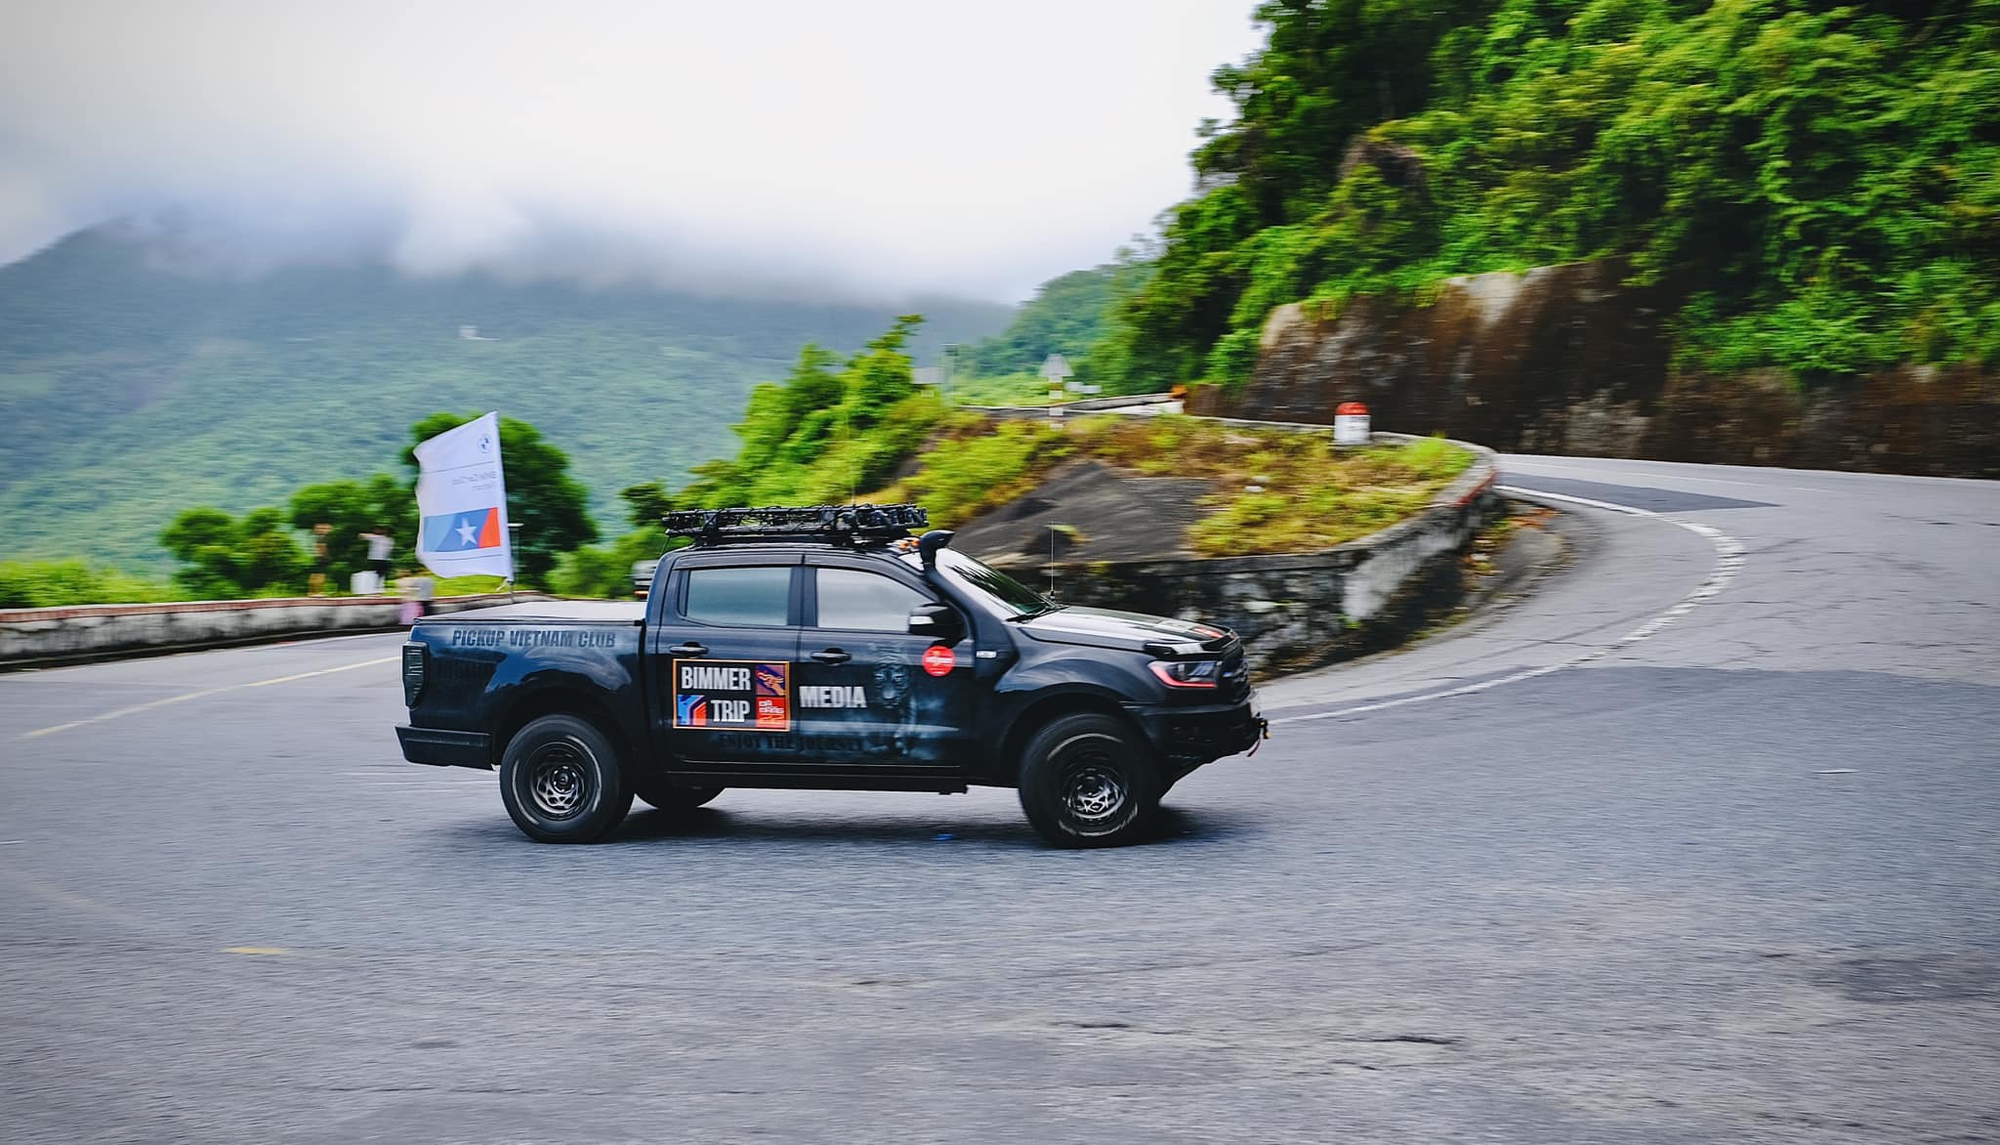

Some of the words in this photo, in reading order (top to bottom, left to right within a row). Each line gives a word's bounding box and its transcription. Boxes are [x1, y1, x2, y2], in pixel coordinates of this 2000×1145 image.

[452, 630, 505, 646] PICKUP
[509, 630, 573, 648] VIETNAM
[577, 631, 616, 648] CLUB
[681, 666, 751, 691] BIMMER
[799, 686, 867, 708] MEDIA
[710, 700, 750, 722] TRIP
